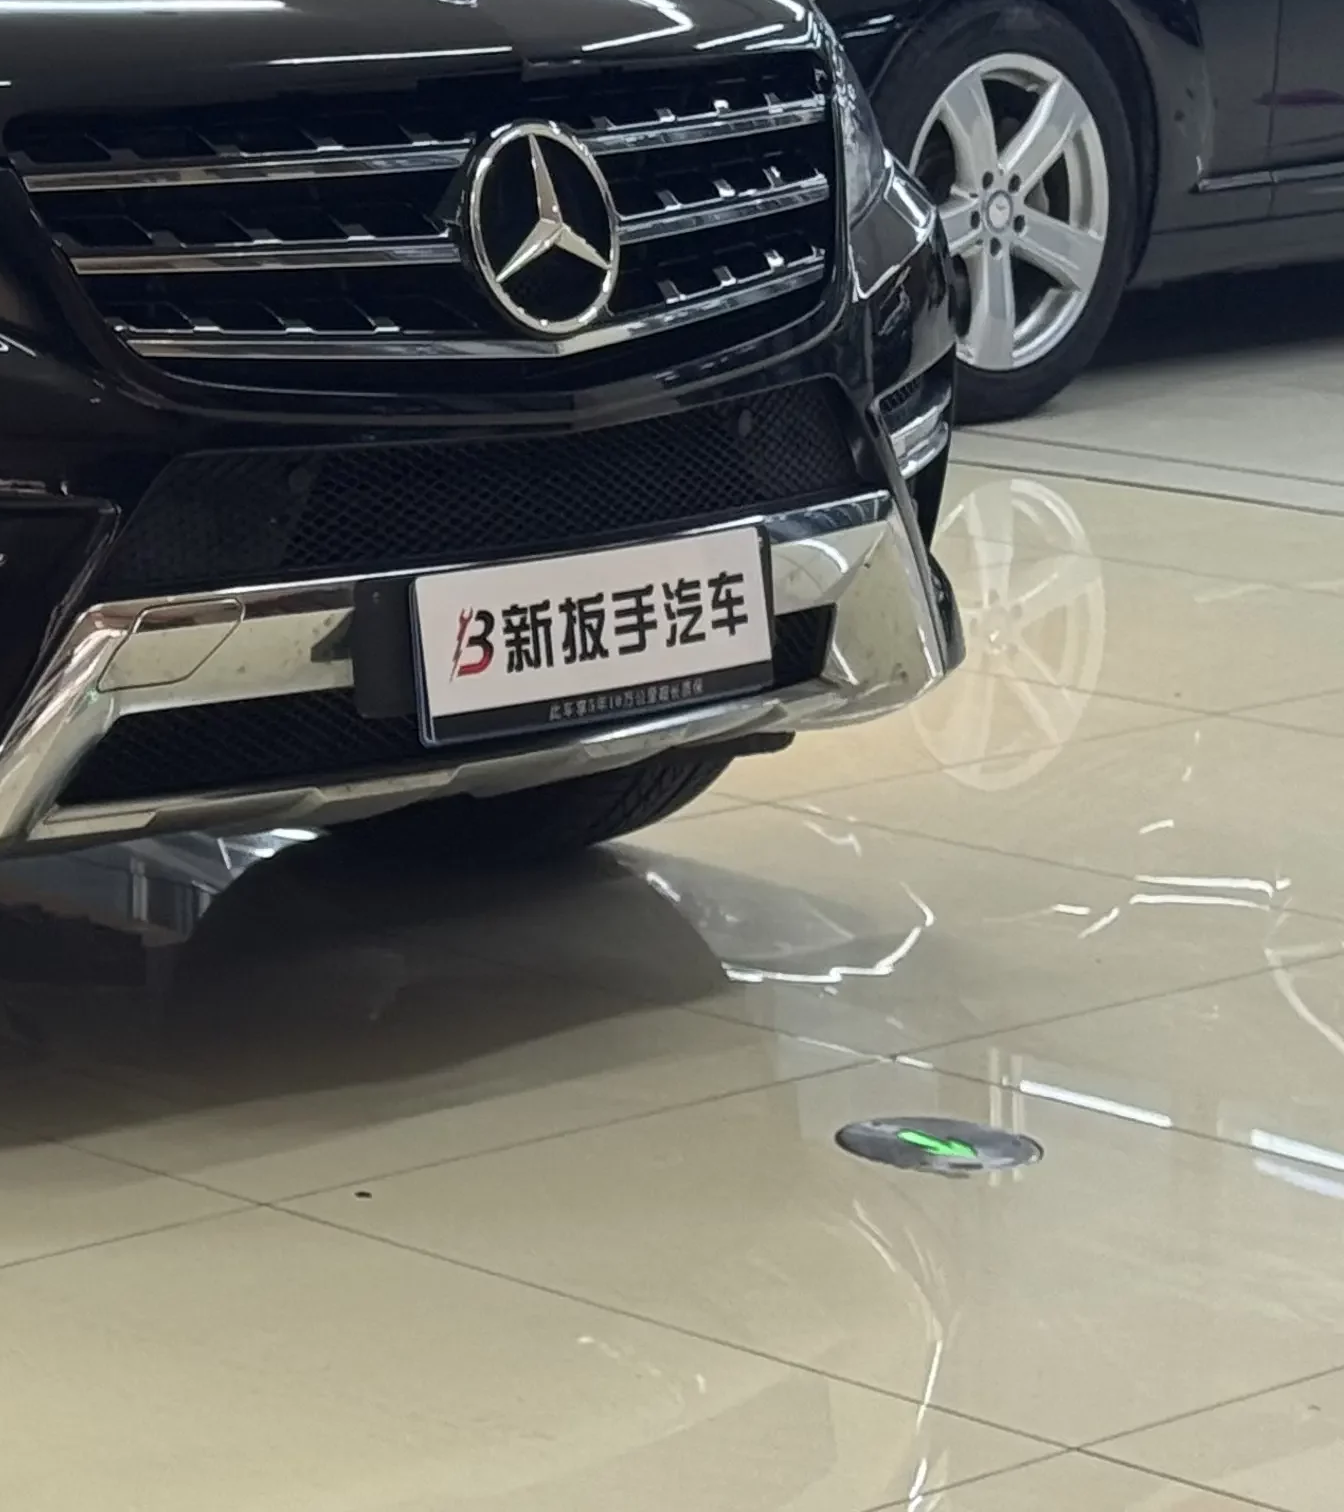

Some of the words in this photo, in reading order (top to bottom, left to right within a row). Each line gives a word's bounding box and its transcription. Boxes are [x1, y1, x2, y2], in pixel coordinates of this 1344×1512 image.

[501, 570, 749, 674] 新扳手汽车
